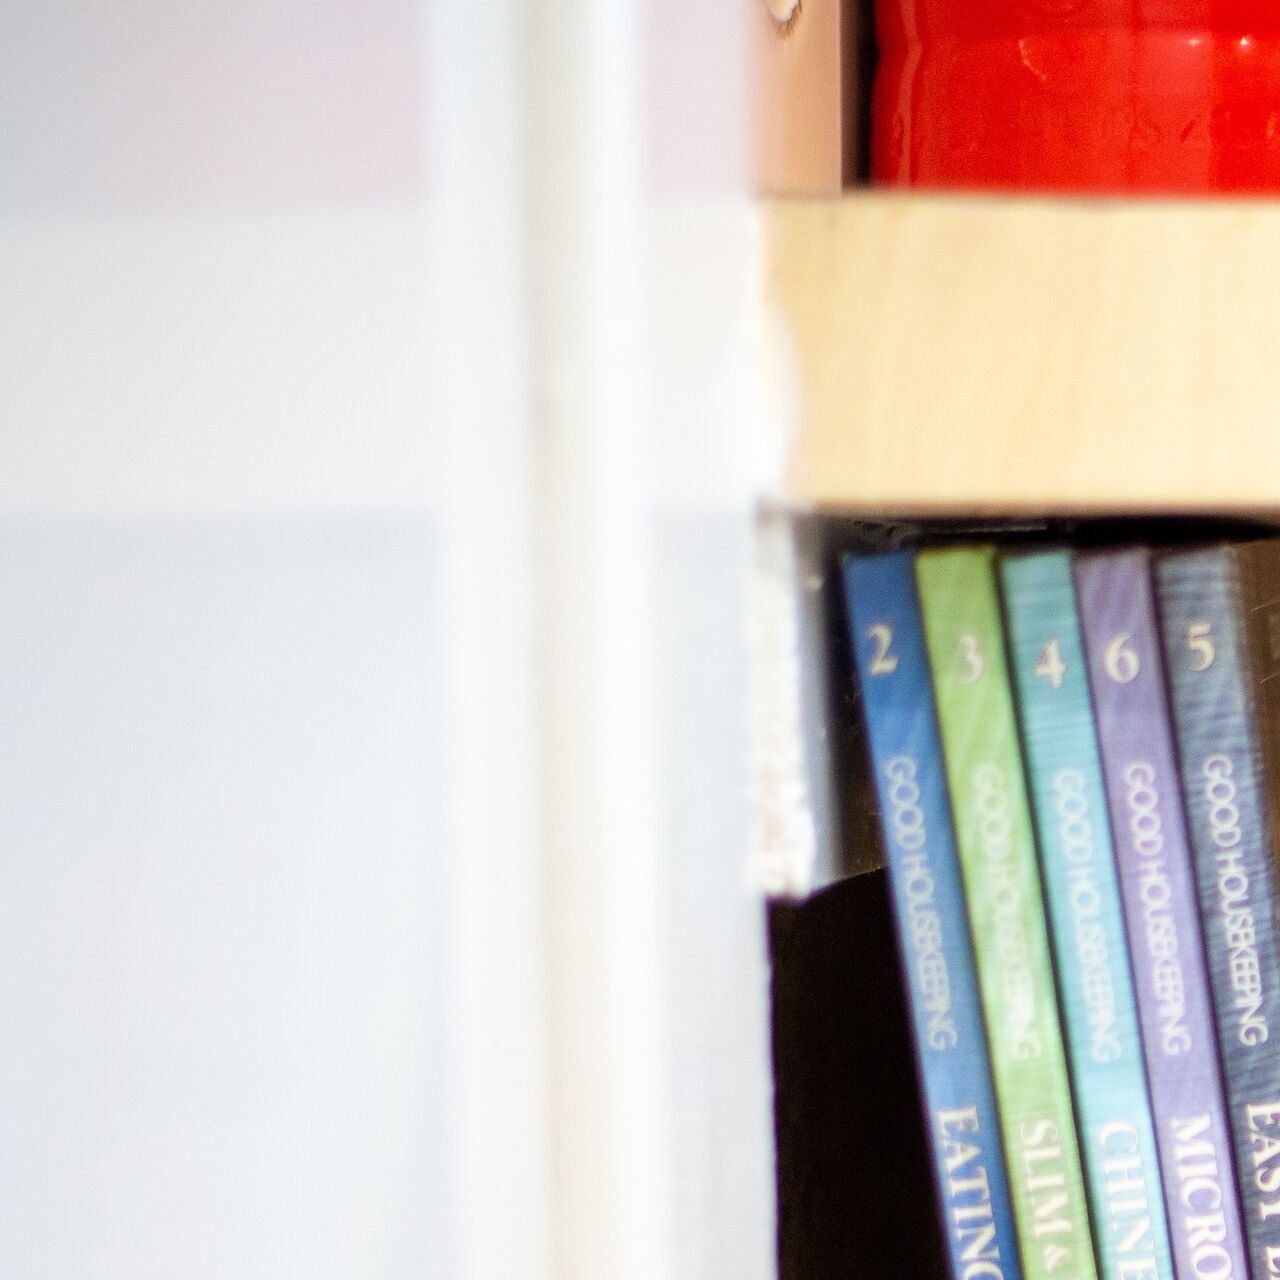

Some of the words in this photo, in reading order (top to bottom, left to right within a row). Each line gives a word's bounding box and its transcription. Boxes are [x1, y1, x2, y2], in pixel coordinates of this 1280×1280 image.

[868, 624, 897, 675] 2
[957, 633, 985, 684] 3
[1034, 638, 1067, 689] 4
[1104, 631, 1140, 684] 6
[1184, 622, 1217, 672] 5
[885, 755, 926, 851] GOOD
[973, 761, 1013, 861] GOOD
[1052, 767, 1093, 864] GOOD
[1123, 761, 1164, 855] GOOD
[1203, 756, 1243, 847] GOOD
[903, 854, 958, 1051] HOUSEKEEPING
[1137, 859, 1193, 1056] HOUSEKEEPING
[1216, 851, 1270, 1047] HOUSEKEEPING
[1020, 1117, 1074, 1239] SLIM
[1043, 1243, 1071, 1271] &
